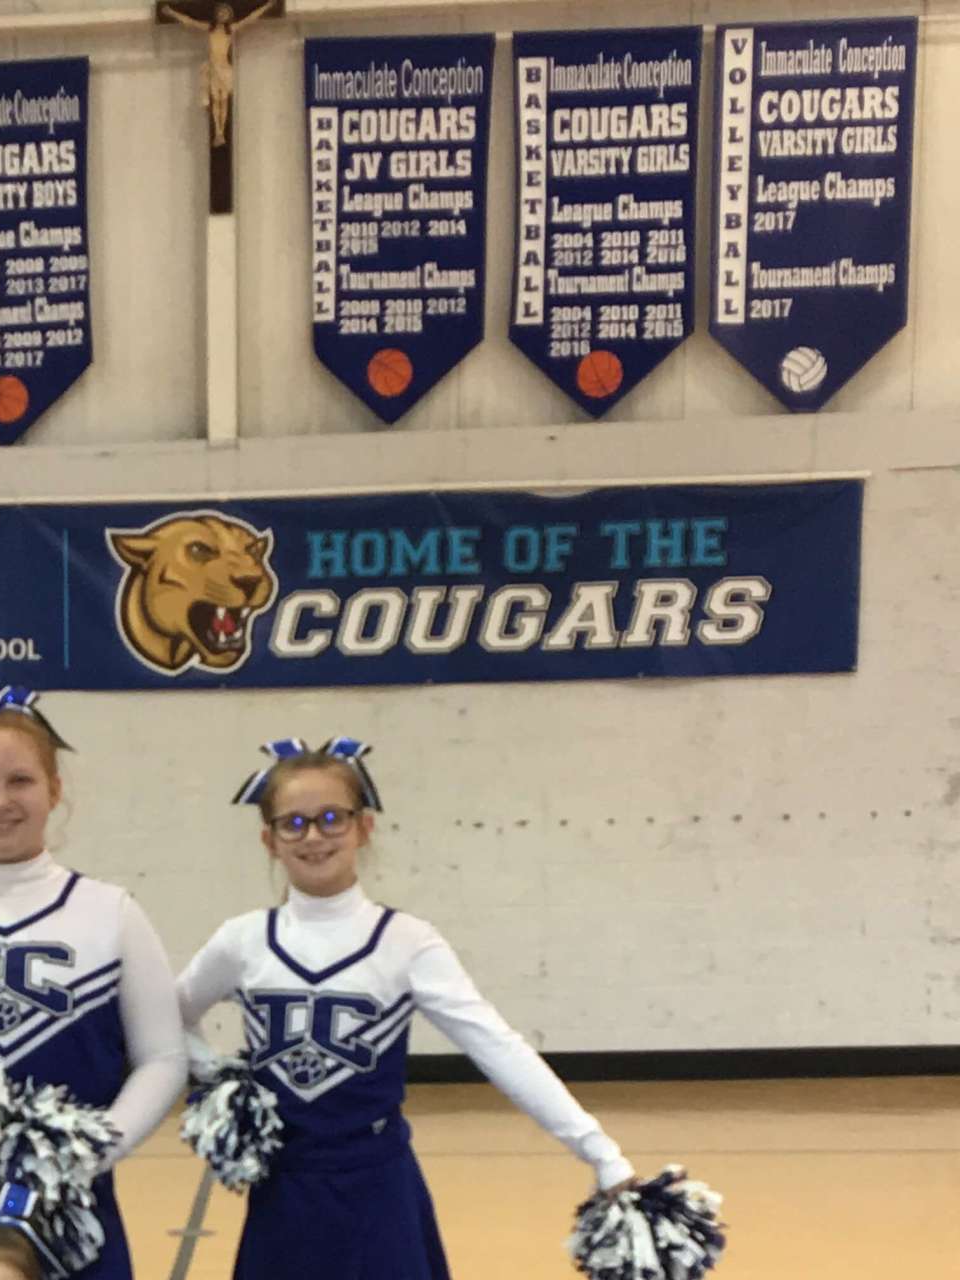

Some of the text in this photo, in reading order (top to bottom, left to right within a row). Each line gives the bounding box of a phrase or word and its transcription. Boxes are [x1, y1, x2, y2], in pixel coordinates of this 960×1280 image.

[549, 48, 692, 98] Immaculate Conception
[760, 35, 906, 79] Immaculate Conception
[314, 57, 484, 104] Immaculate Conception
[14, 85, 80, 134] Conception
[759, 85, 900, 124] COUGARS
[342, 106, 476, 143] COUGARS
[553, 102, 688, 142] COUGARS
[757, 124, 898, 157] VARSITY GIRLS
[344, 149, 472, 180] JV GIRLS
[551, 143, 690, 176] VARSITY GIRLS
[724, 38, 747, 315] VOLLEYBALL
[32, 179, 77, 208] BOYS
[342, 183, 474, 218] League Champs
[522, 67, 542, 318] BASKETBALL
[756, 171, 896, 208] League Champs
[314, 117, 333, 314] BASKETBALL
[551, 193, 683, 228] League Champs
[753, 211, 797, 232] 2017
[19, 221, 82, 251] Champs
[340, 219, 467, 238] 2010 2012 2014
[601, 230, 640, 247] 2010
[648, 229, 684, 245] 2011
[553, 250, 593, 267] 2012
[601, 249, 639, 266] 2014
[751, 257, 896, 292] Tournament Champs
[48, 275, 87, 293] 2017
[340, 263, 421, 290] Tournament
[547, 266, 685, 297] Tournament Champs
[384, 299, 423, 314] 2010
[426, 297, 467, 314] 2012
[599, 304, 639, 321] 2010
[644, 303, 682, 320] 2011
[750, 298, 793, 319] 2017
[550, 322, 591, 338] 2012
[598, 322, 636, 339] 2014
[4, 350, 44, 368] 2017
[307, 517, 728, 578] HOME OF THE
[270, 576, 771, 659] COUGARS
[249, 989, 384, 1073] IC
